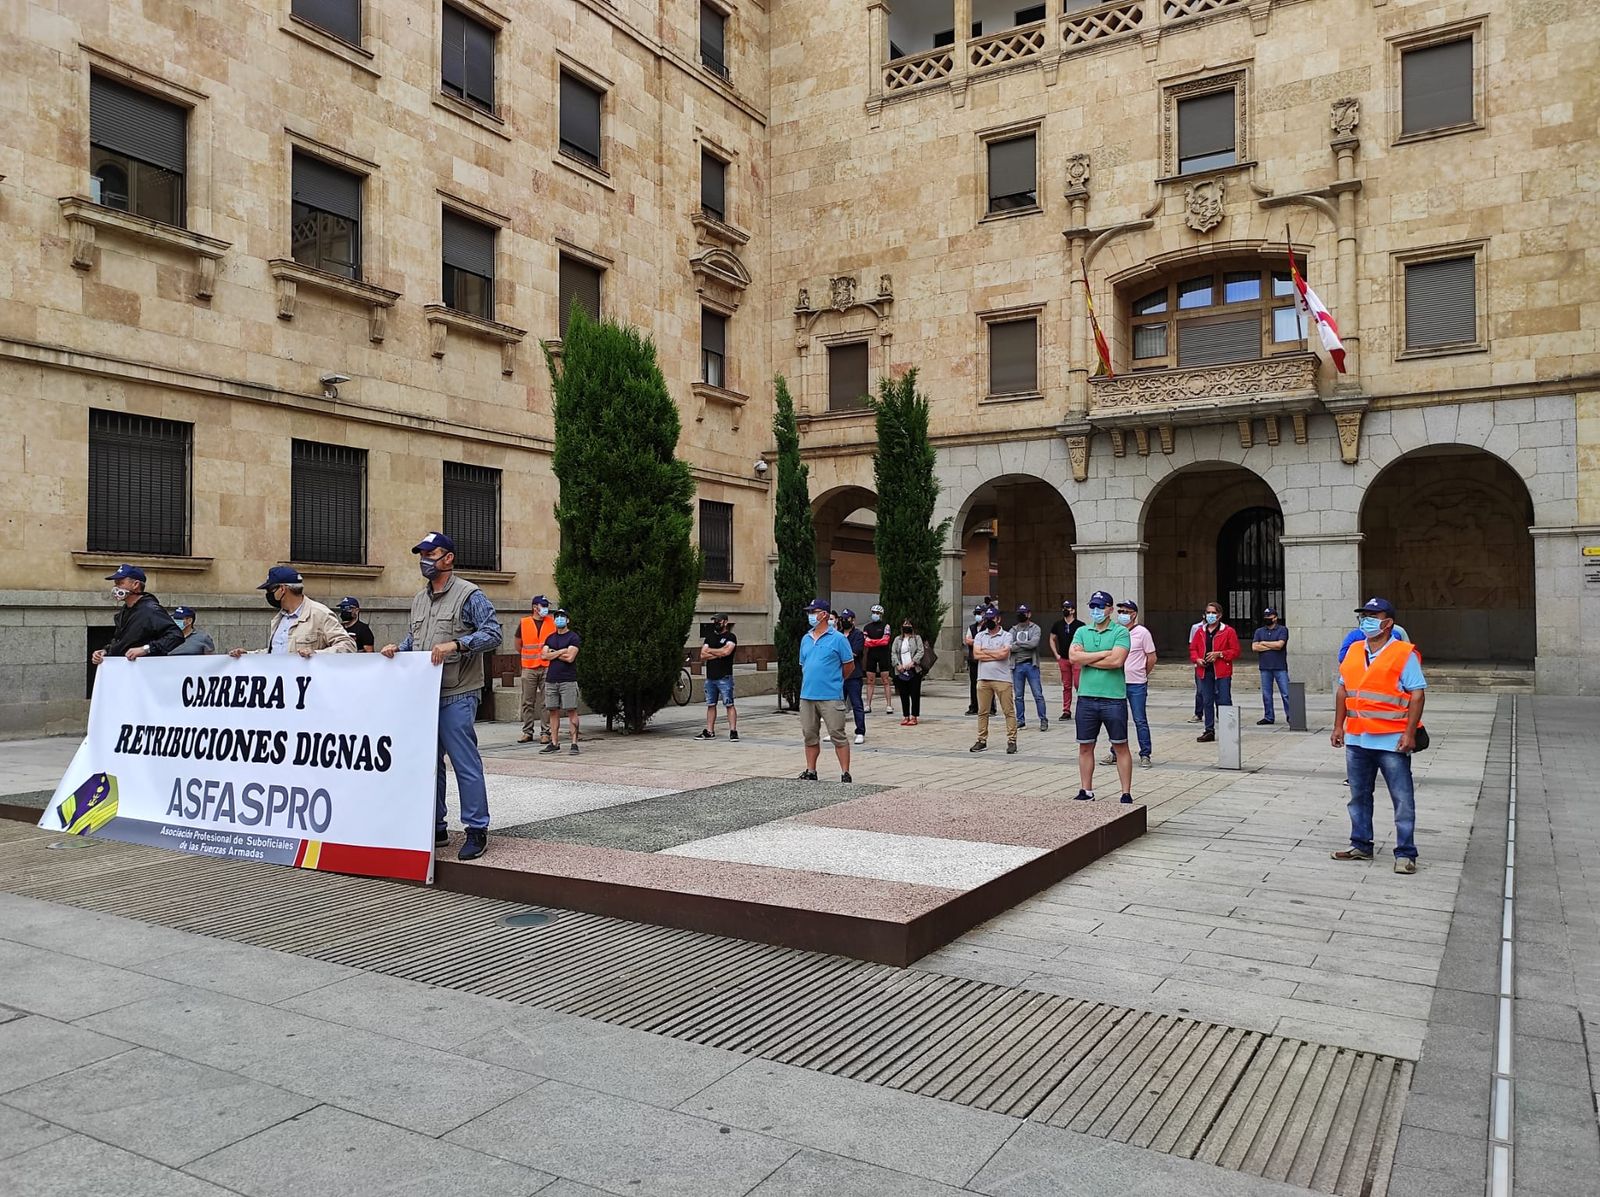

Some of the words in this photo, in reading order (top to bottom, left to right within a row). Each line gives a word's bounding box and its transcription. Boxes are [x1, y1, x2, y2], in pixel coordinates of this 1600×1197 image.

[182, 676, 285, 709] CARRERA
[296, 676, 311, 709] Y
[114, 724, 288, 765] RETRIBUCIONES
[293, 732, 392, 772] DIGNAS
[166, 777, 332, 834] ASFASPRO
[179, 840, 188, 850] de
[189, 841, 199, 851] las
[200, 843, 227, 855] Fuerzas
[228, 846, 264, 859] Armadas
[194, 830, 233, 844] Profesional
[233, 834, 244, 846] de
[246, 836, 294, 850] Suboficiales
